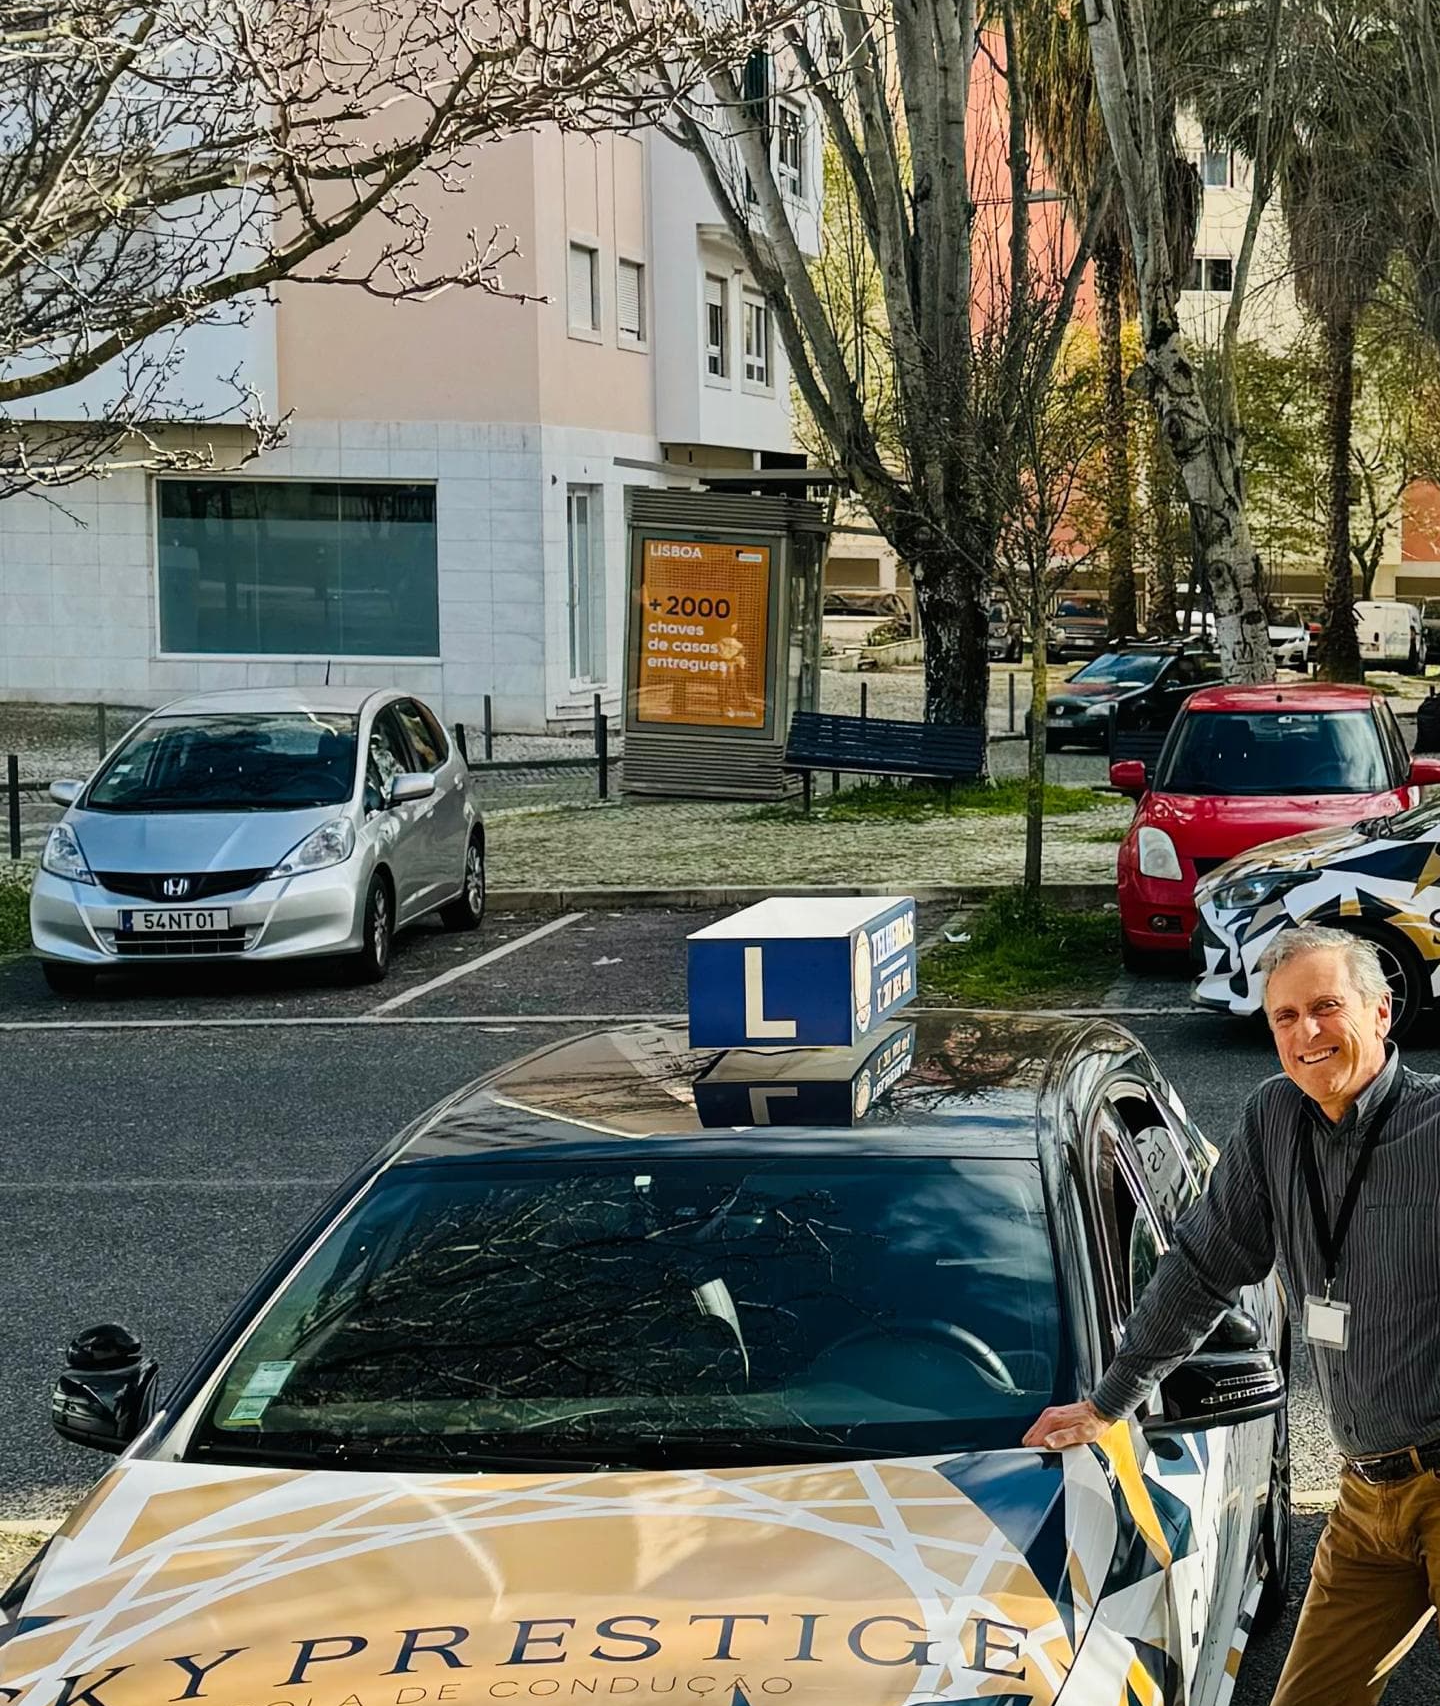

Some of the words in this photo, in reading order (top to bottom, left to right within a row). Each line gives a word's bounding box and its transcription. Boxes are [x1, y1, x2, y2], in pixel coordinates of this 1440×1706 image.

[650, 544, 702, 559] LISBOA
[648, 622, 704, 636] chaves
[648, 638, 667, 651] de
[672, 640, 719, 654] casas
[647, 656, 728, 673] entregues
[744, 946, 797, 1039] L
[273, 1613, 1029, 1688] PRESTIGE
[396, 1682, 463, 1706] DE
[489, 1672, 793, 1699] CONDUÇÃO
